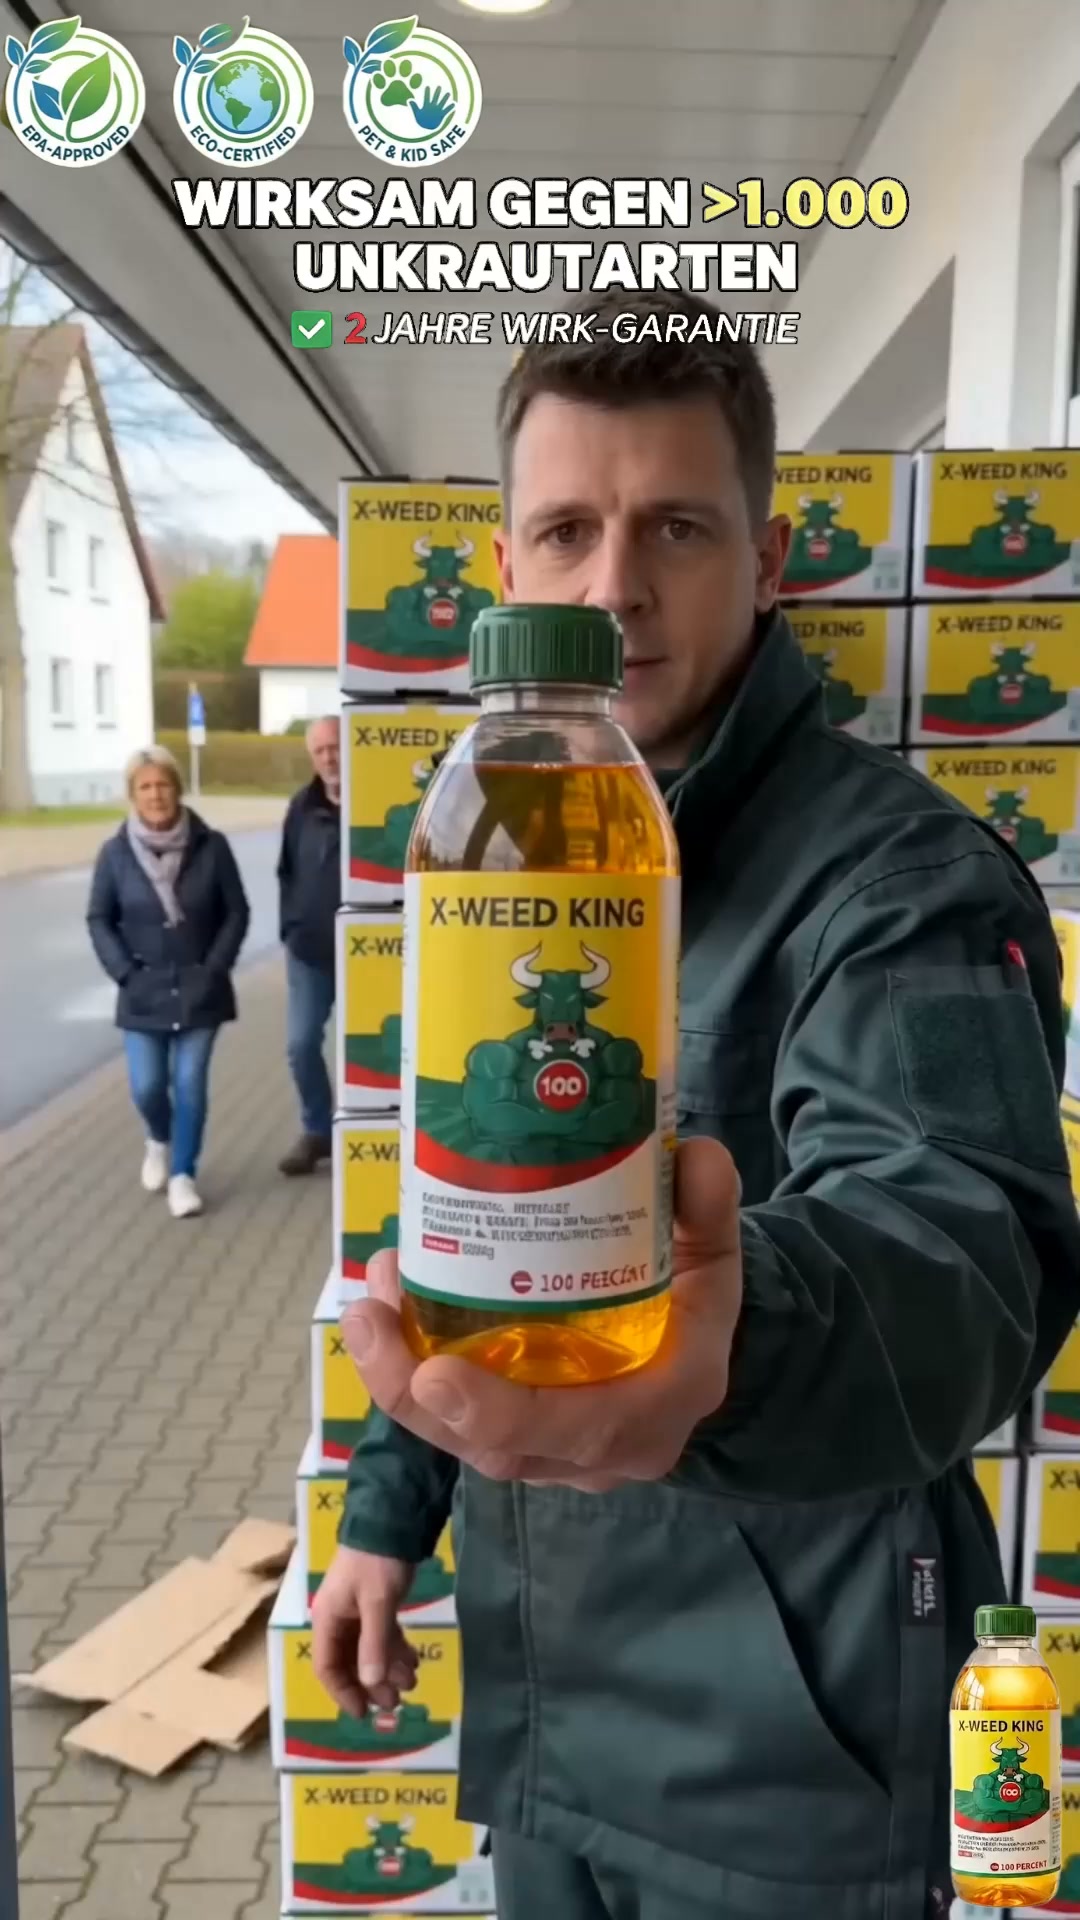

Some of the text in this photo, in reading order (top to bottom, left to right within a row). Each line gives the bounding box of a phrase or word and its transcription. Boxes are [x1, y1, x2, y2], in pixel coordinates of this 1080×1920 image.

[824, 466, 873, 484] KING
[940, 462, 1067, 480] X-WEED KING
[353, 500, 501, 523] X-WEED KING
[936, 614, 1063, 634] X-WEED KING
[354, 726, 438, 747] X-WEED
[932, 758, 1056, 778] X-WEED KING
[430, 897, 645, 927] X-WEED KING
[541, 1076, 582, 1097] 100
[541, 1273, 574, 1292] 100
[304, 1787, 447, 1805] X-WEED KING
